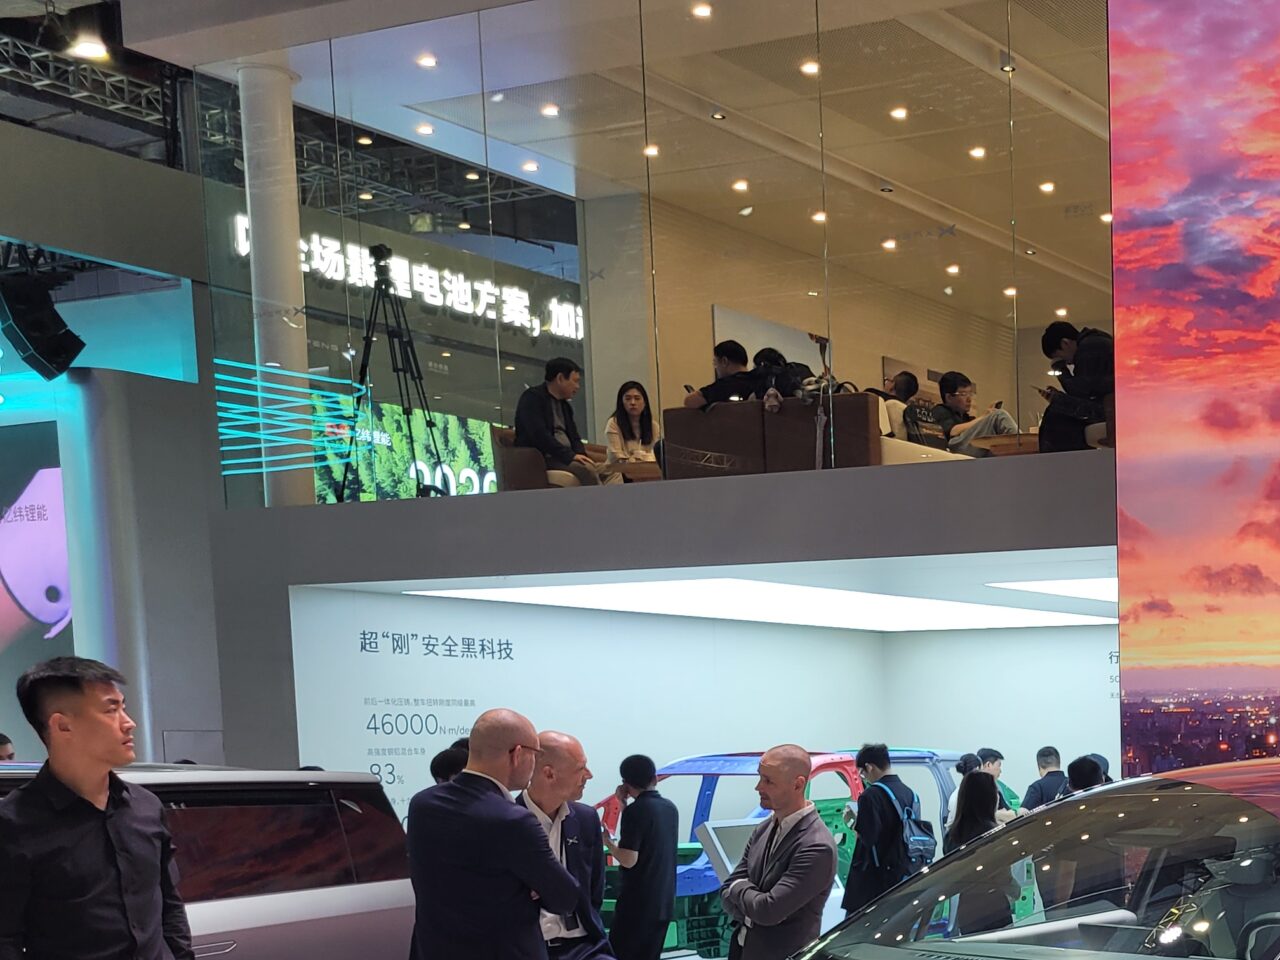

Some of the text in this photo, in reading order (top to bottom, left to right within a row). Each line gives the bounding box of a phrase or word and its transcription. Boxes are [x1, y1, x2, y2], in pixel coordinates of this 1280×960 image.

[359, 629, 515, 661] 超“刚”安全黑科技
